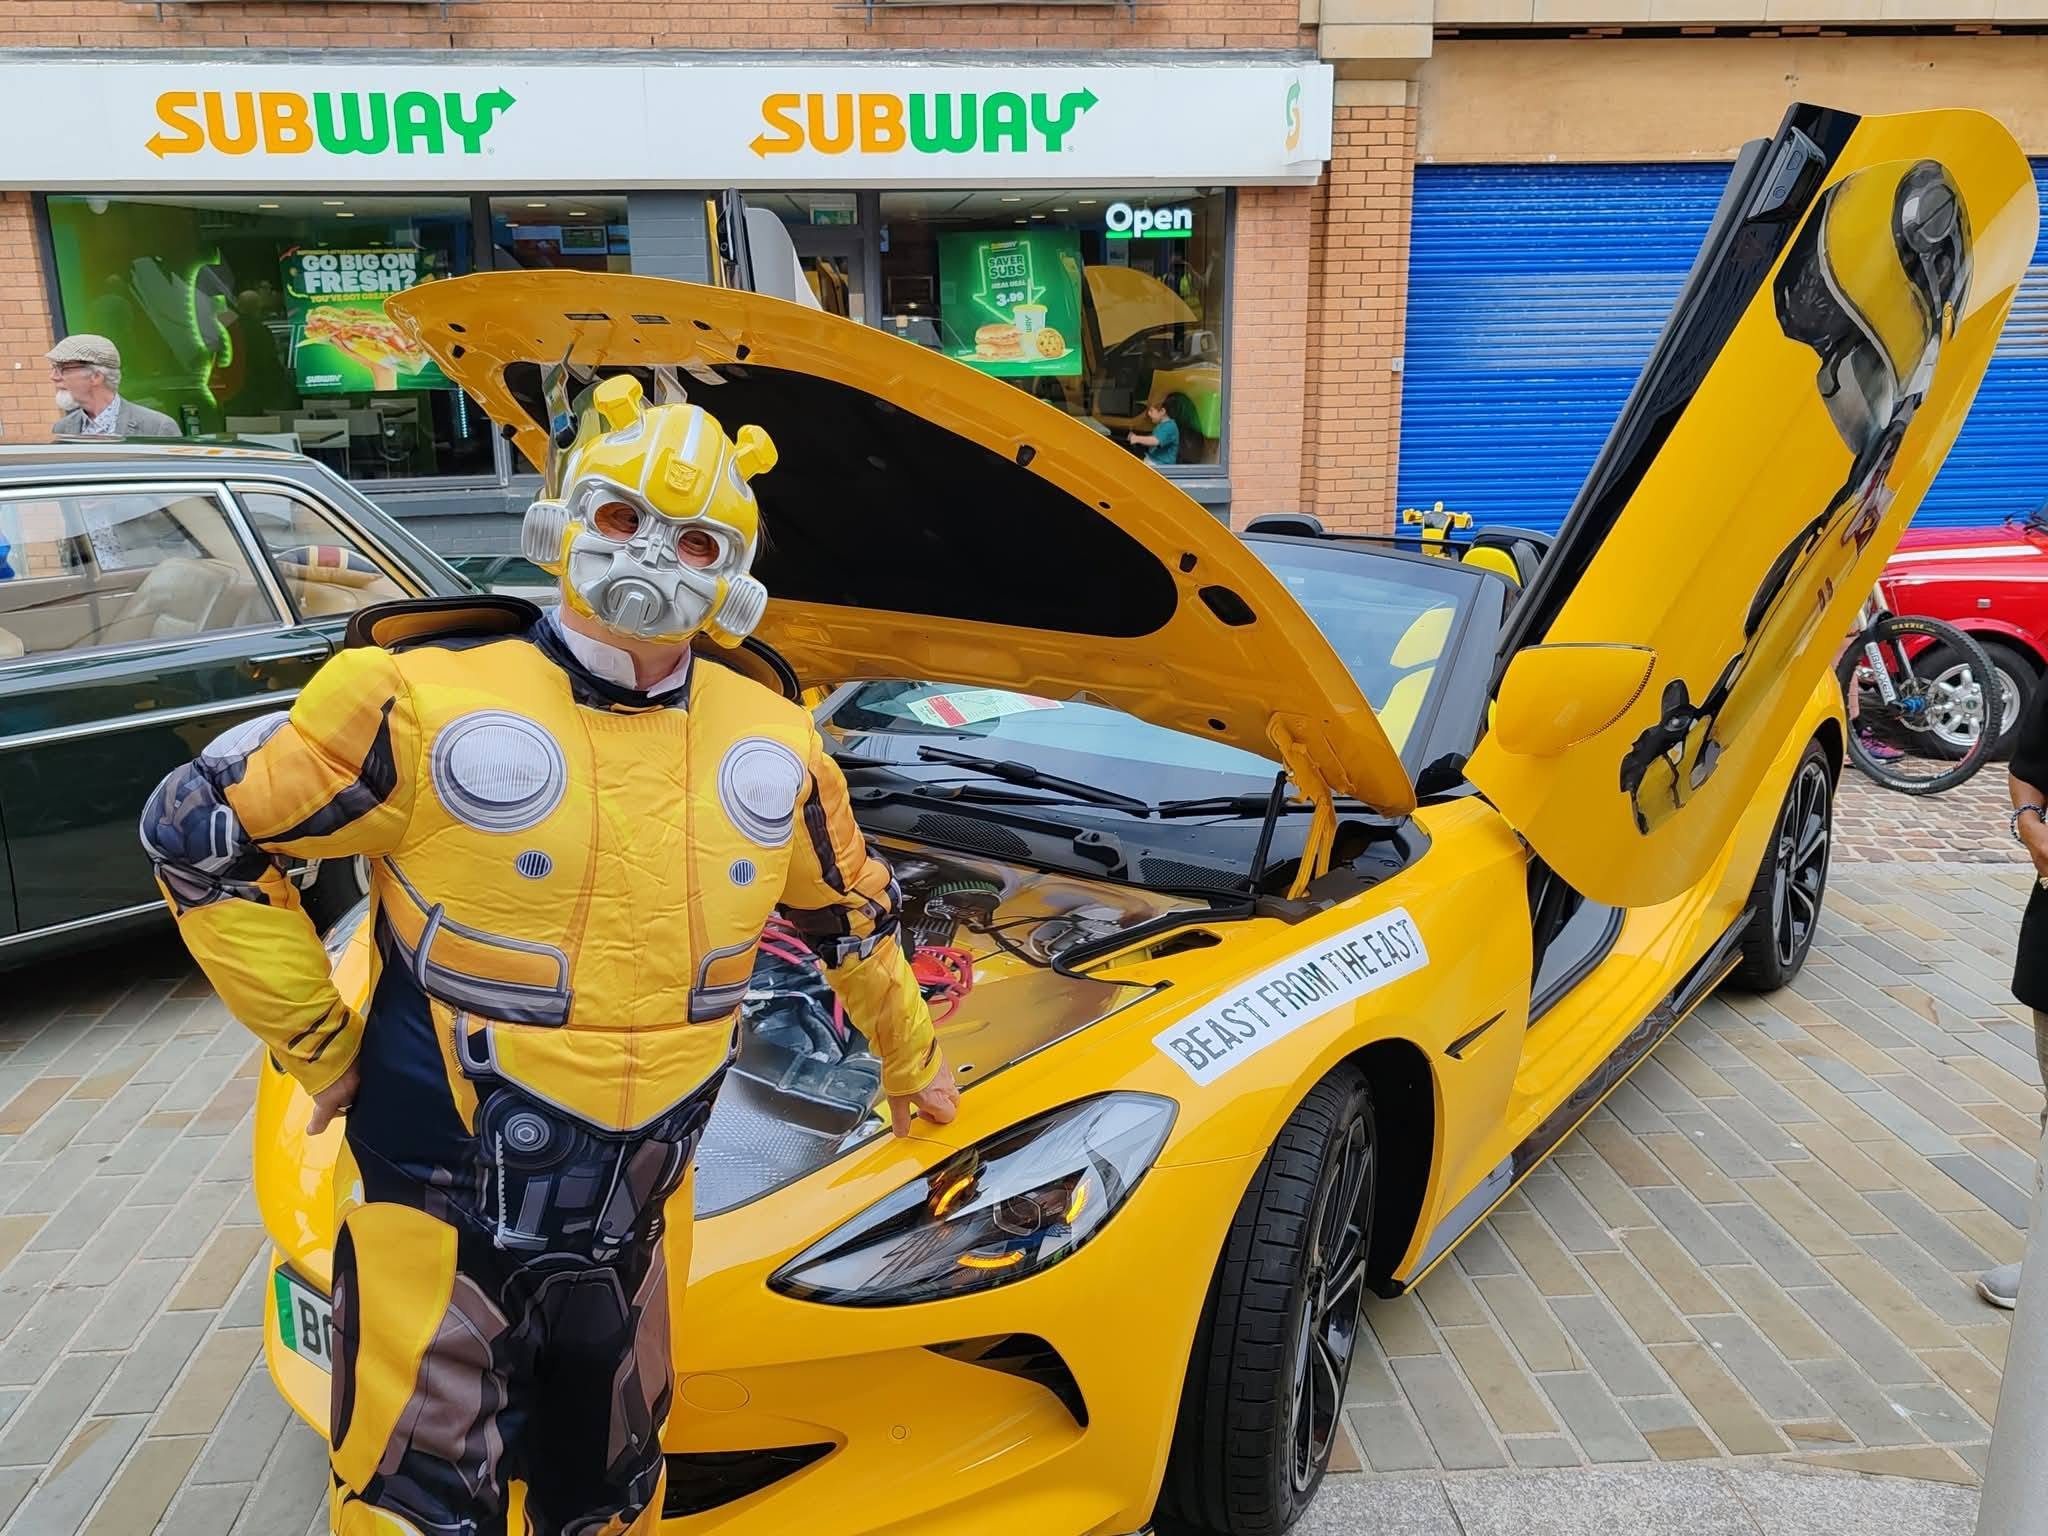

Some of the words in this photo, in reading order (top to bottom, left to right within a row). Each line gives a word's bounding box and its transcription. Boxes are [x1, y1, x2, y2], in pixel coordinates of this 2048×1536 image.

[145, 87, 516, 158] SUBWAY
[749, 87, 1099, 158] SUBWAY
[1105, 203, 1193, 238] Open
[302, 254, 338, 271] GO
[340, 254, 380, 271] BIG
[382, 253, 416, 270] ON
[989, 255, 1025, 267] SAVER
[990, 265, 1026, 278] SUBS
[303, 270, 417, 293] FRESH?
[996, 292, 1025, 306] 3.99
[1871, 654, 1896, 700] BOXXER
[1168, 997, 1270, 1071] BEAST
[1255, 962, 1340, 1018] FROM
[1319, 941, 1379, 985] THE
[1362, 919, 1420, 969] EAST
